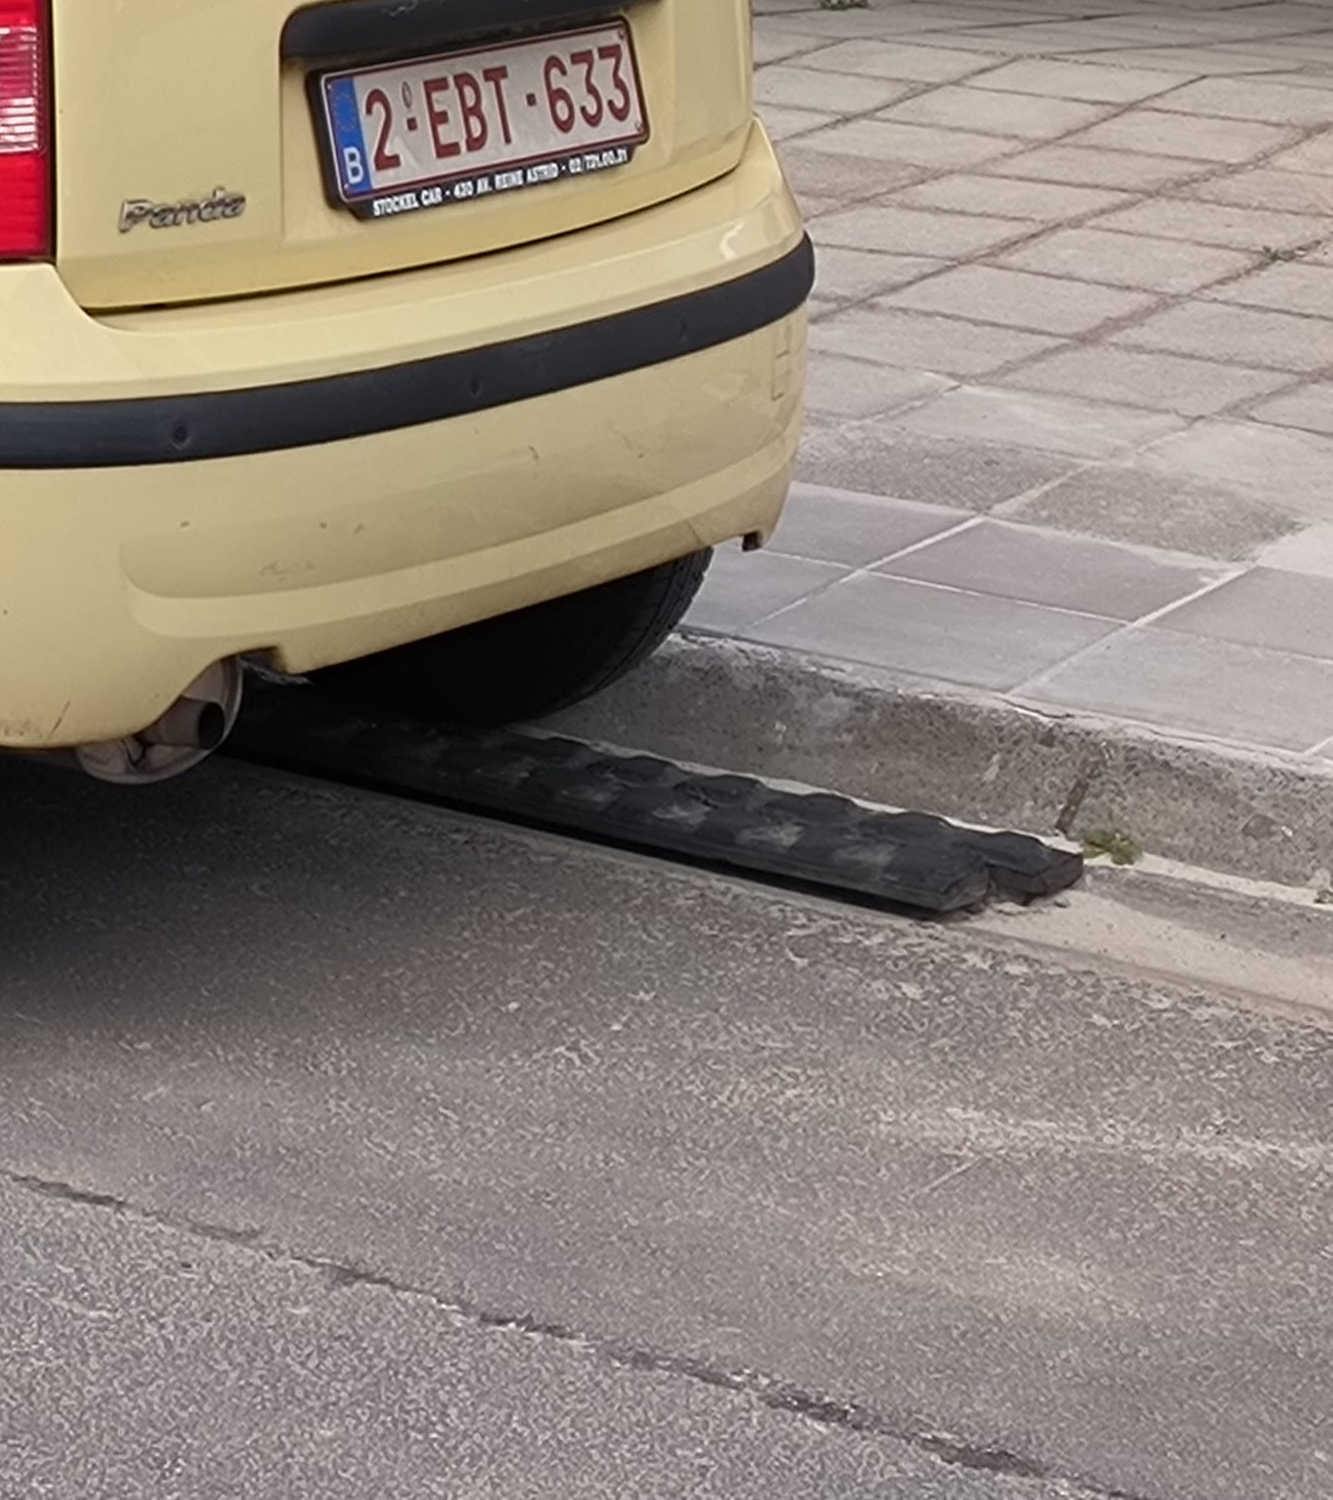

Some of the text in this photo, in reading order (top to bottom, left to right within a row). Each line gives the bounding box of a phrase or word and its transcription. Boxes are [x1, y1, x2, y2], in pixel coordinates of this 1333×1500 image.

[343, 146, 364, 184] B
[118, 185, 247, 234] Panda
[420, 187, 443, 206] CAR
